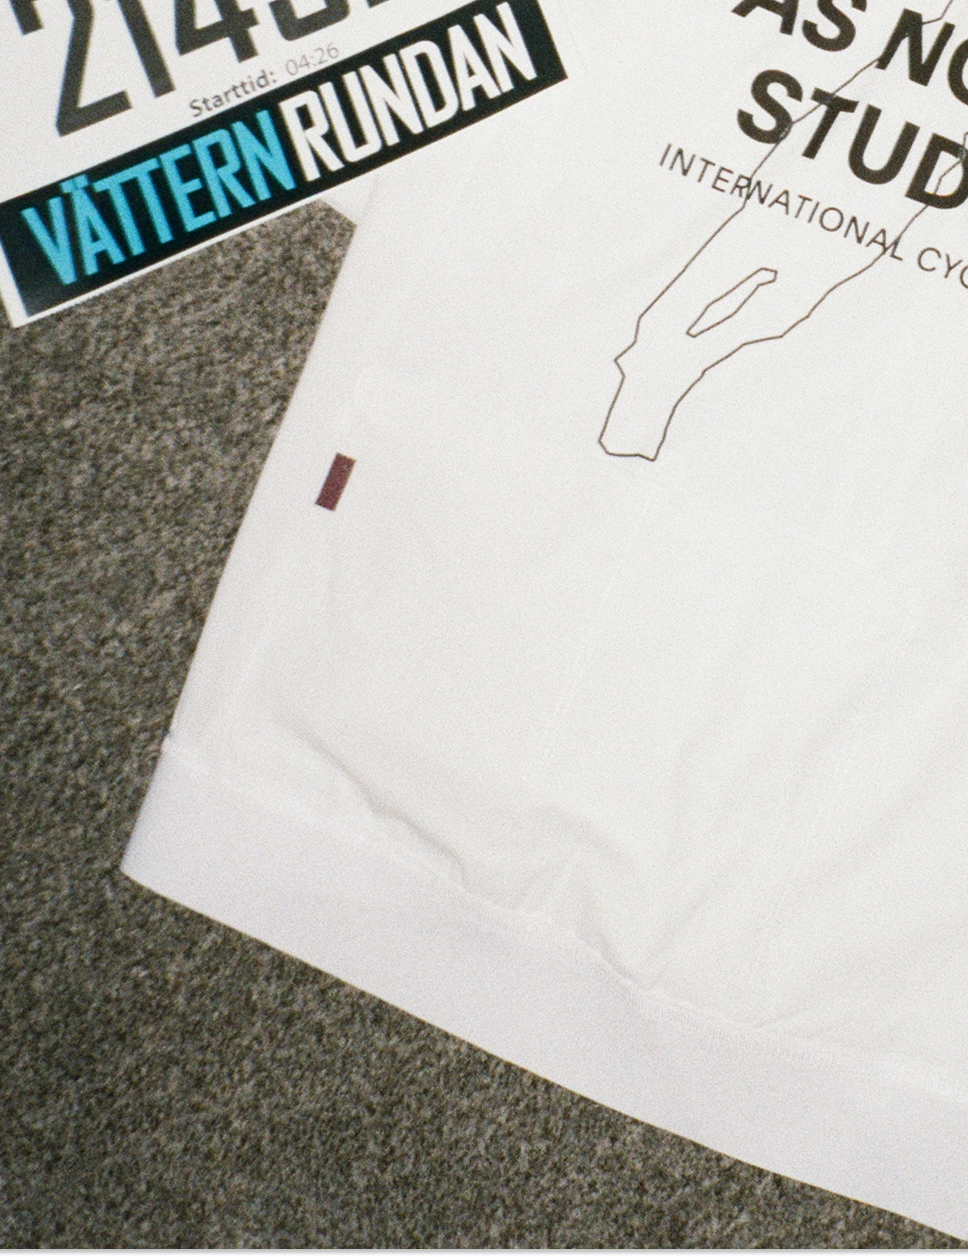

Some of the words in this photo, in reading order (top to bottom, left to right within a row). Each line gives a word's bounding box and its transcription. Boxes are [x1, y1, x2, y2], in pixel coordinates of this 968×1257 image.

[188, 68, 278, 118] Starttid:
[284, 42, 340, 77] 04:26
[659, 143, 905, 261] INTERNATIONAL
